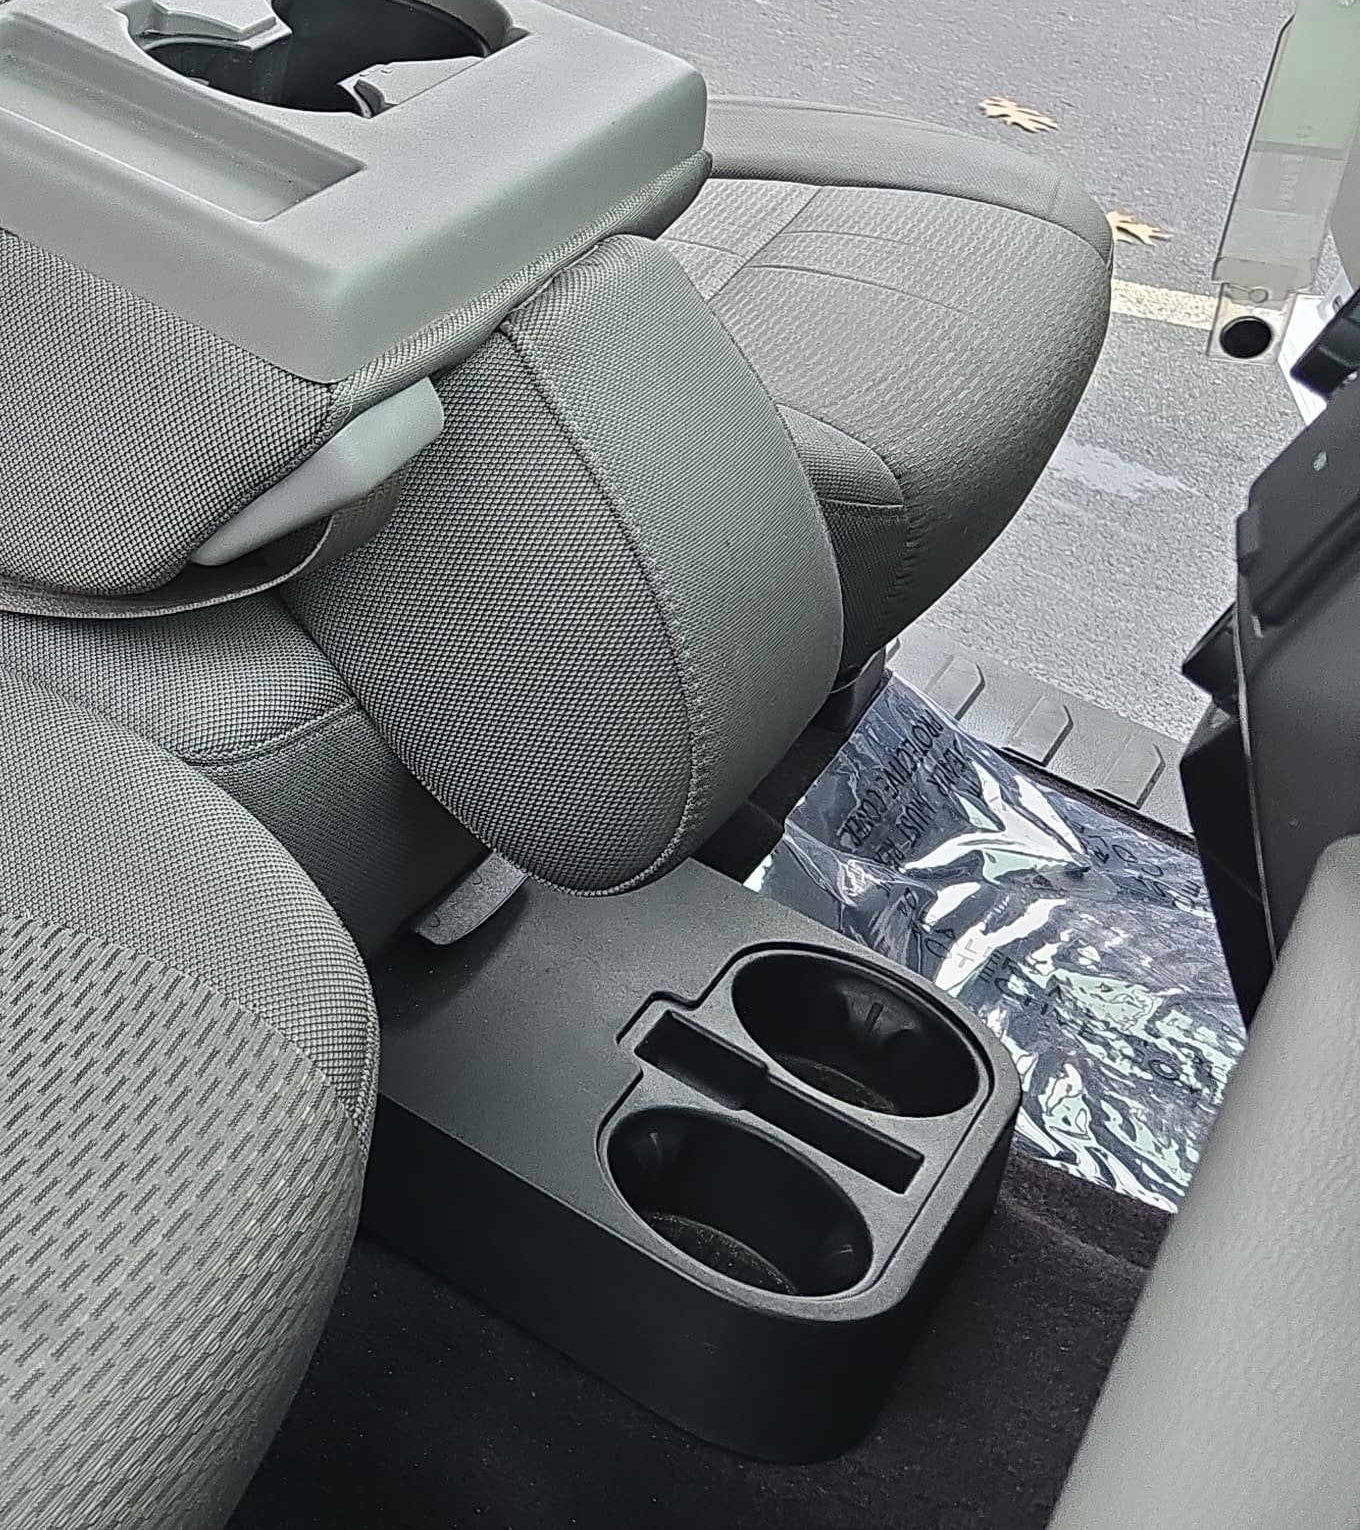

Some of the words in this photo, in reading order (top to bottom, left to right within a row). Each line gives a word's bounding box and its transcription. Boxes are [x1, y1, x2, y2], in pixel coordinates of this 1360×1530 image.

[876, 708, 944, 802] PROTECTIVE
[838, 788, 887, 848] COVER
[896, 791, 940, 849] MUST
